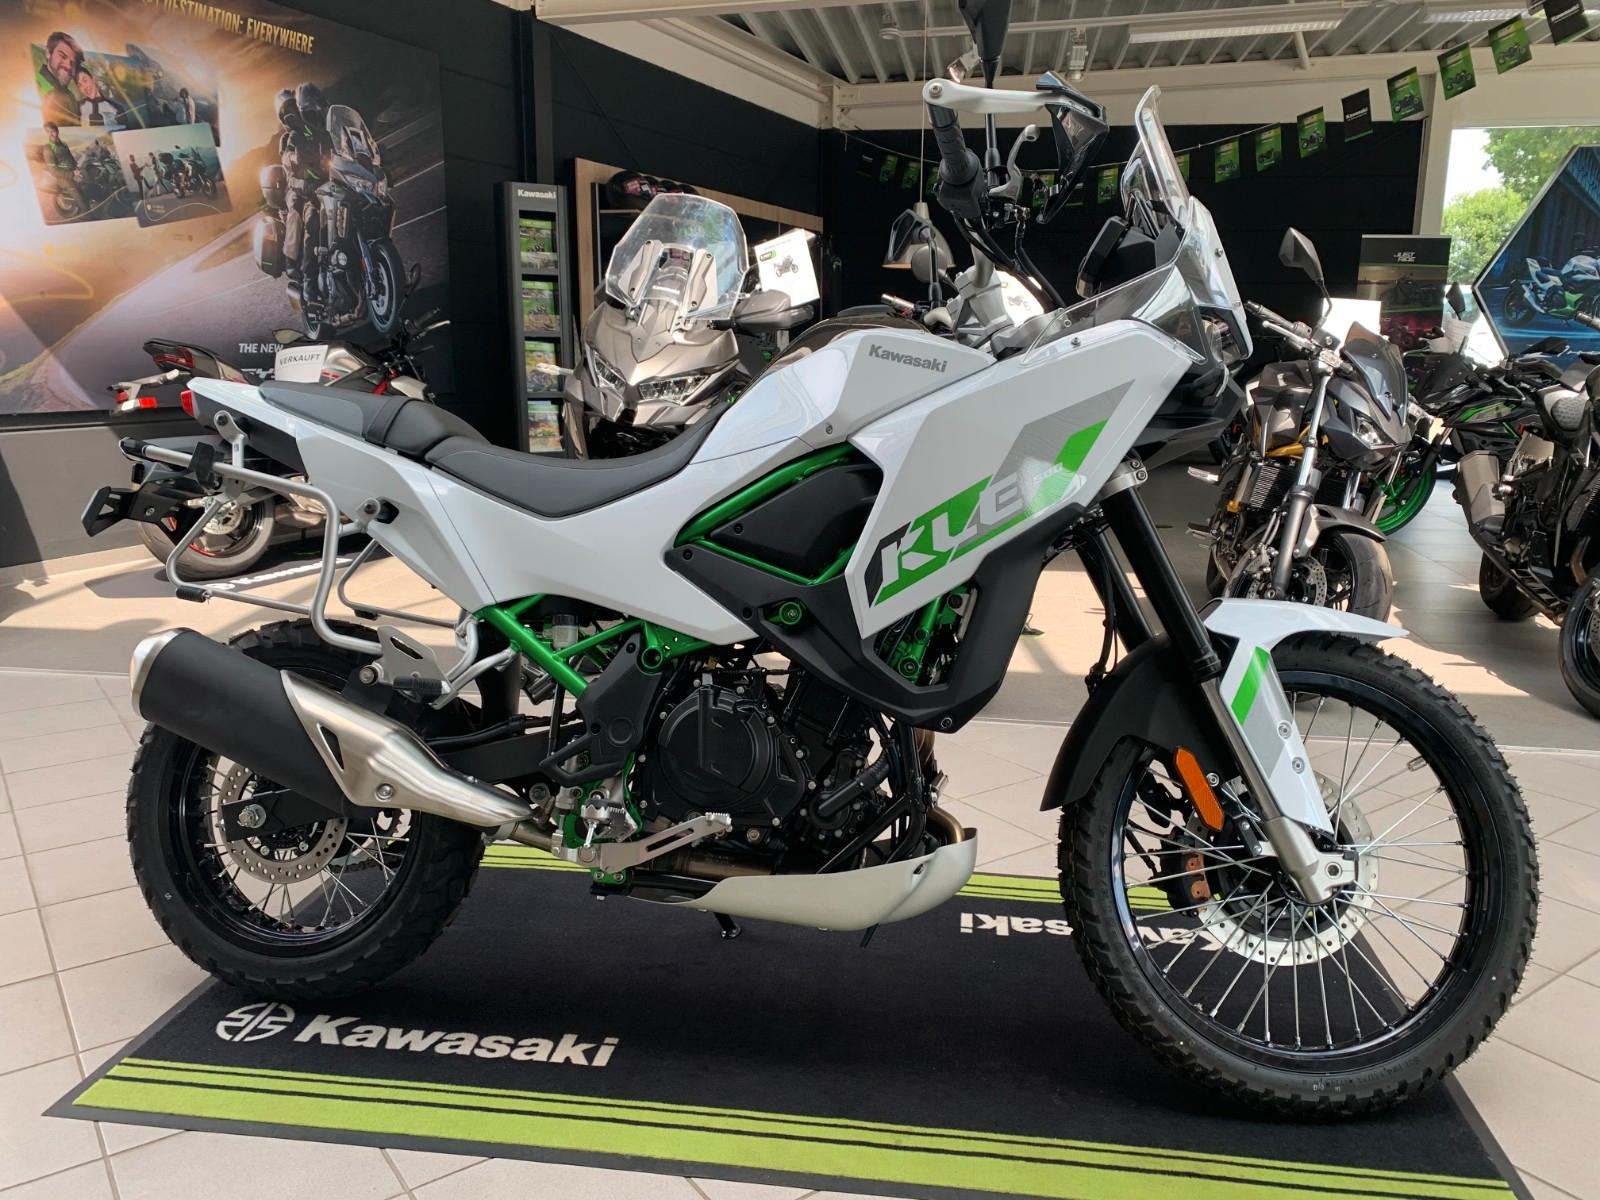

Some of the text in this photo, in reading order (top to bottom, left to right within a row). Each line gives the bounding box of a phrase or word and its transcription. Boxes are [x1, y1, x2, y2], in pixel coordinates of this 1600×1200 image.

[246, 18, 314, 54] EVERYWHERE
[517, 189, 556, 200] Kawasaki
[239, 343, 283, 353] THE NEW
[279, 353, 320, 365] VERKAUFT
[869, 344, 948, 373] Kawasaki
[880, 472, 1024, 588] KLE
[294, 1014, 619, 1067] Kawasaki
